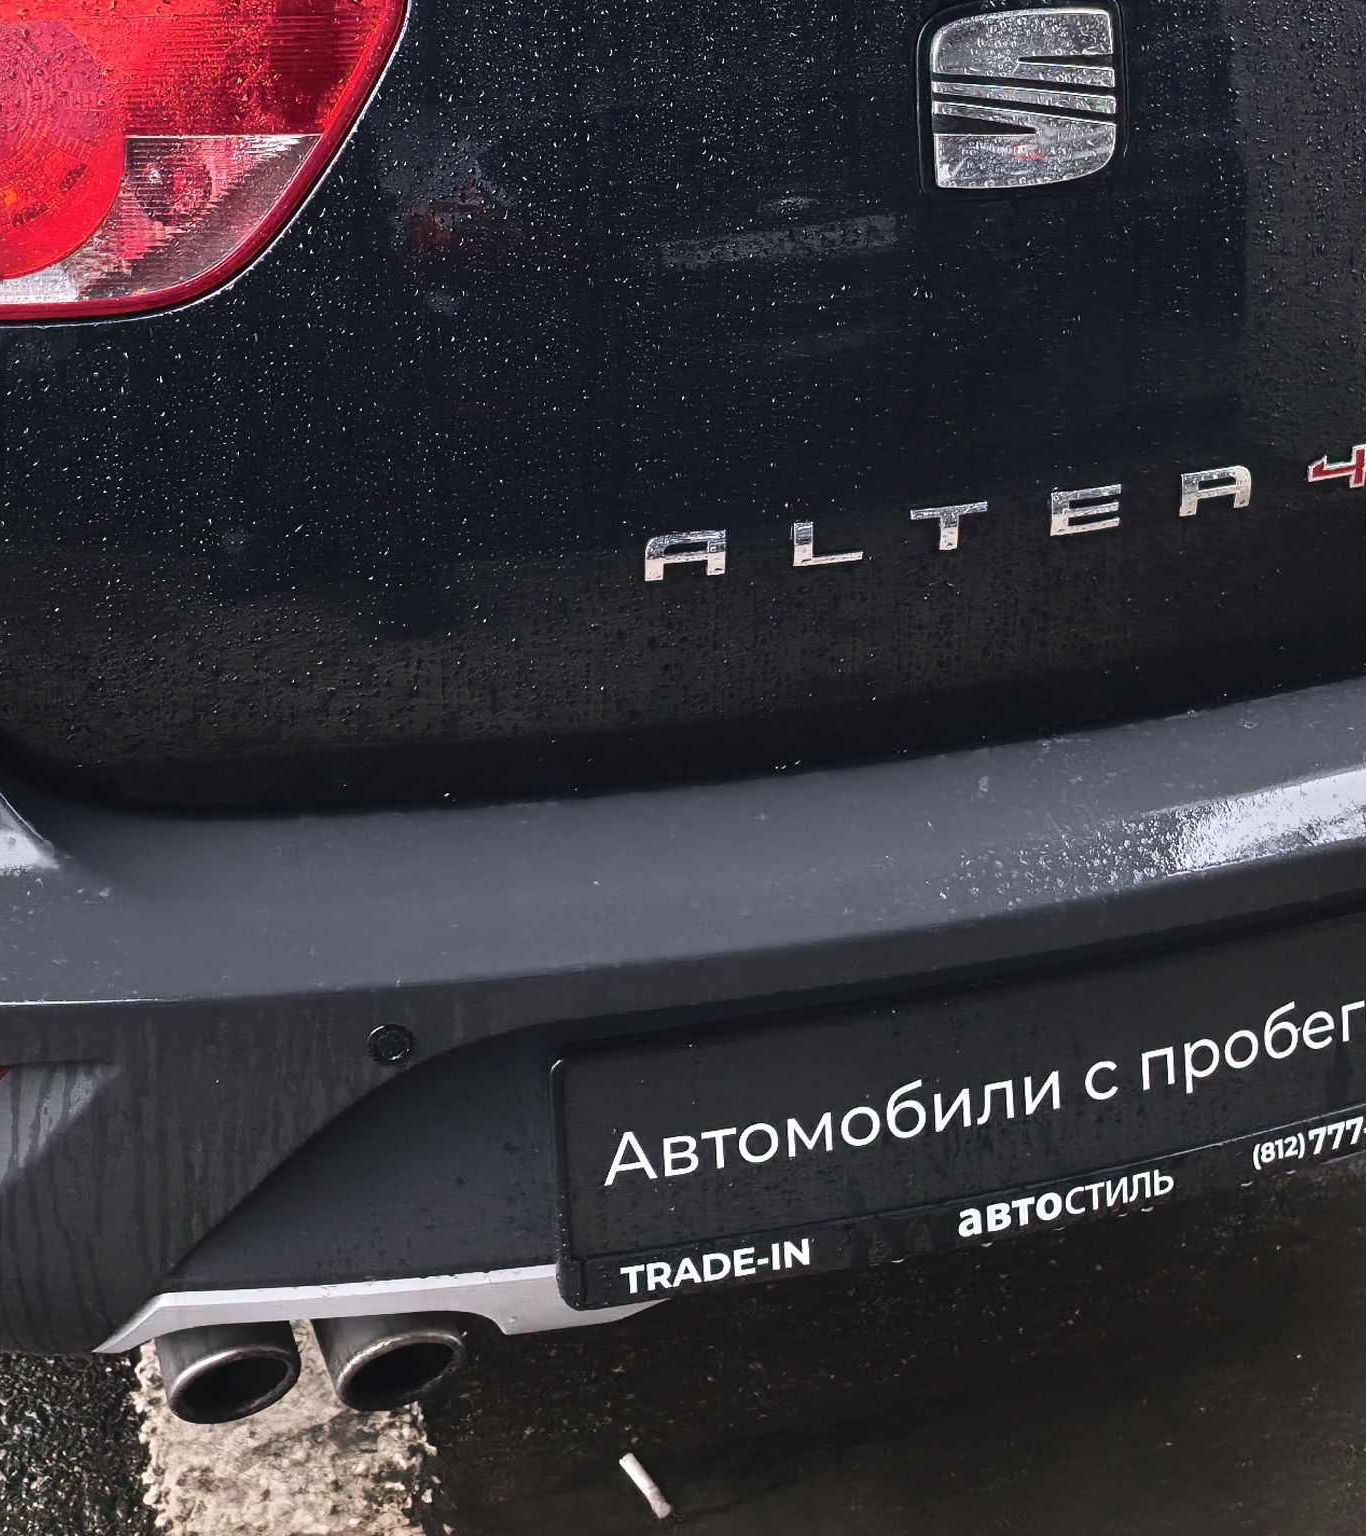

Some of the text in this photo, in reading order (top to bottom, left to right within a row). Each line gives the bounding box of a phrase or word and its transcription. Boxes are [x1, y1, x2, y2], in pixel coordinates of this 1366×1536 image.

[644, 465, 1252, 581] ALTEA
[602, 1069, 1062, 1187] Автомобили
[1083, 1059, 1120, 1101] с
[1251, 1132, 1306, 1171] (812)
[619, 1237, 813, 1295] TRADE-IN
